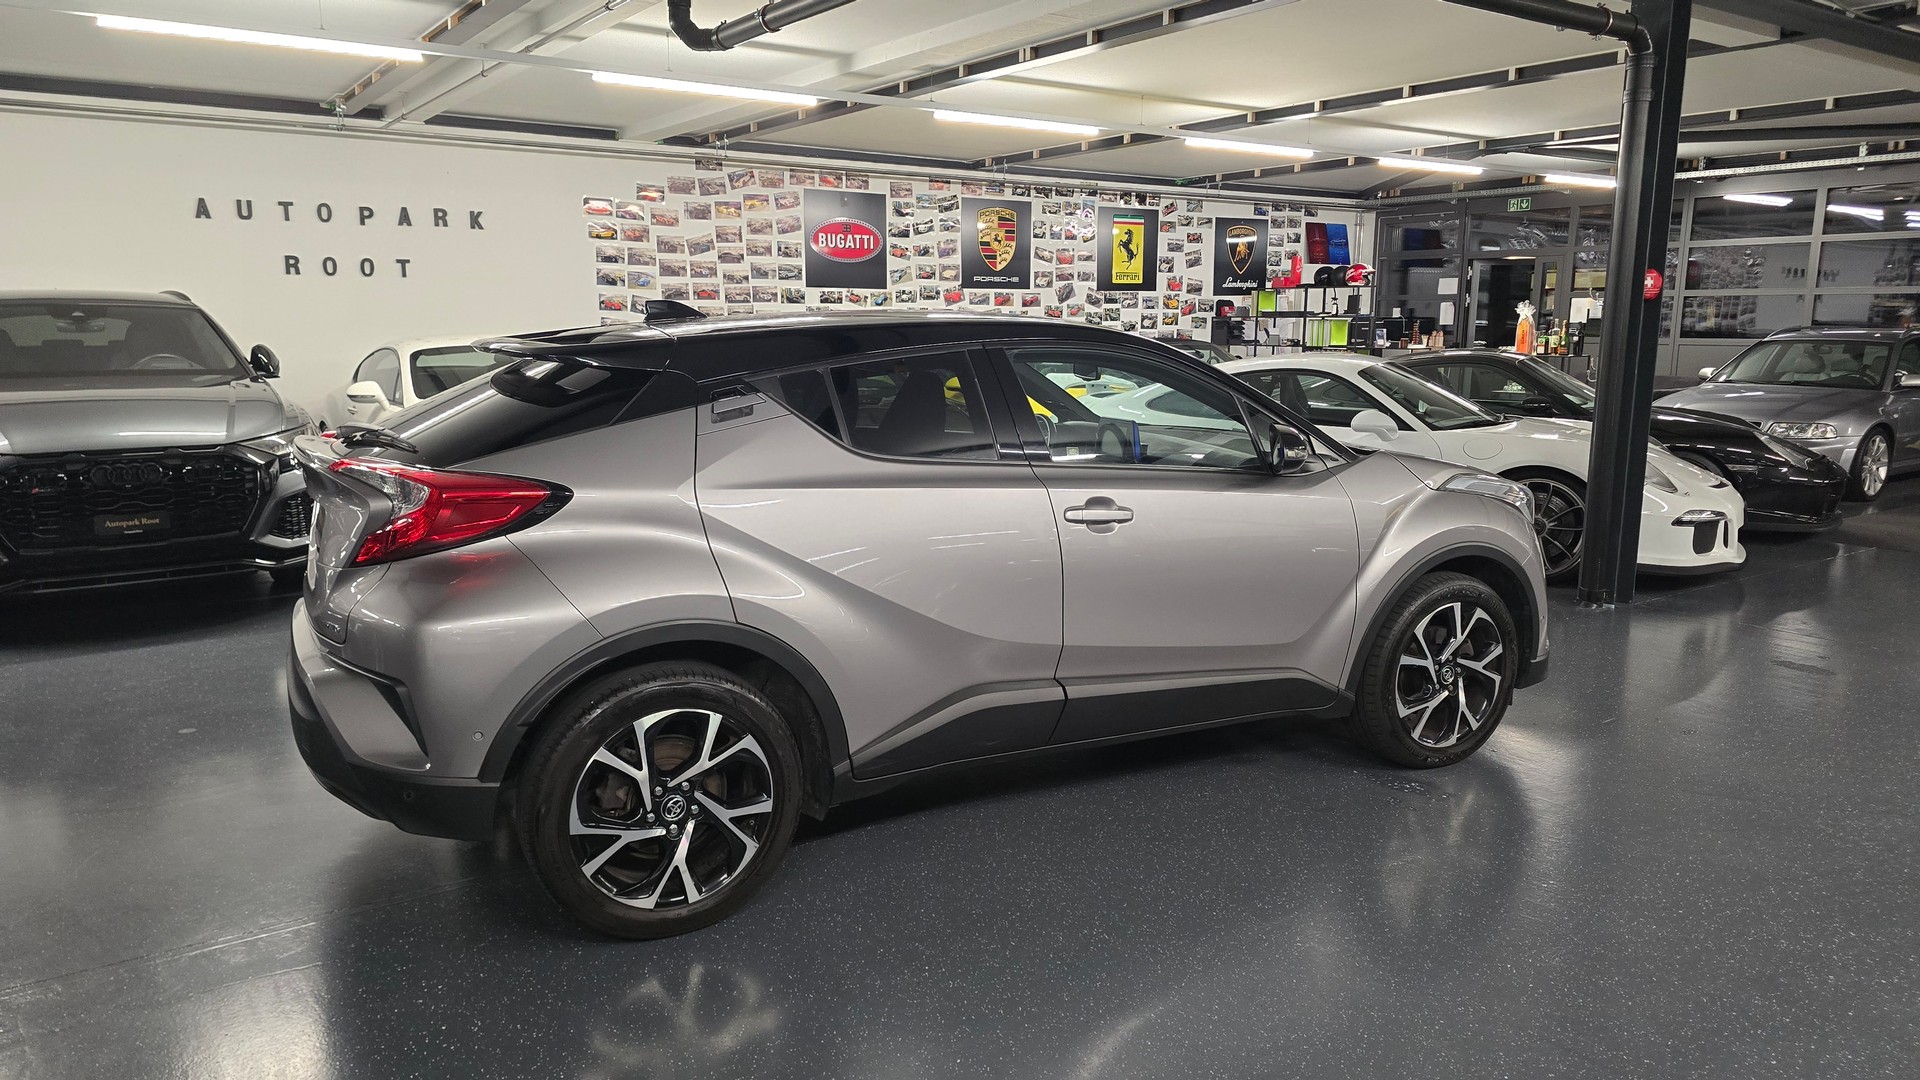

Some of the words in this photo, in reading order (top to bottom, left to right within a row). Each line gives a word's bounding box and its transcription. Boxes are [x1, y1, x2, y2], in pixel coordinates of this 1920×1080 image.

[195, 197, 484, 230] AUTOPARK
[818, 232, 874, 250] BUGATTI
[284, 255, 411, 278] ROOT
[1115, 271, 1140, 281] Ferrari
[1222, 276, 1258, 290] Lamborghini
[105, 518, 140, 528] Autopark
[141, 517, 160, 525] Root
